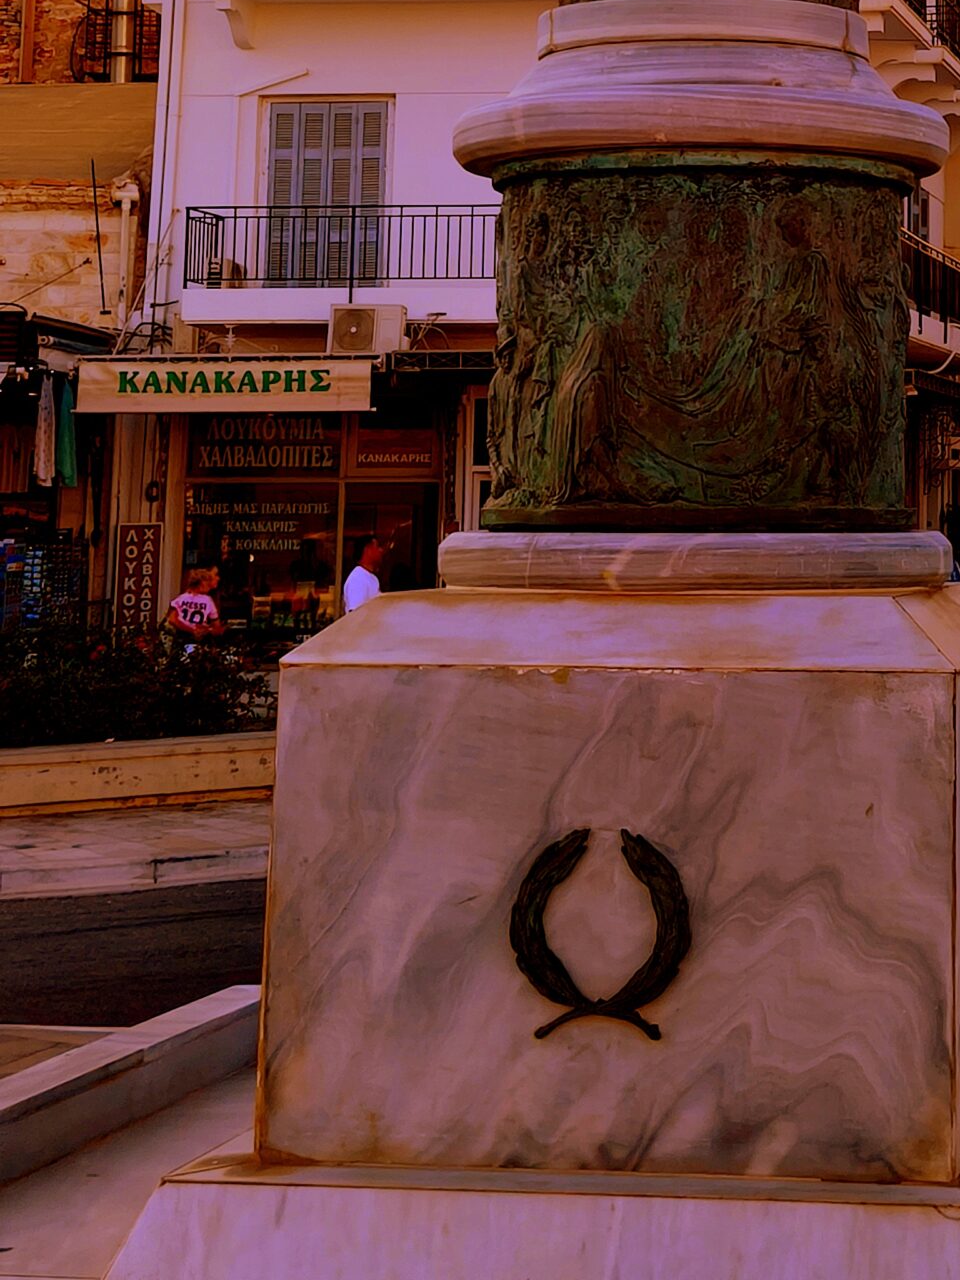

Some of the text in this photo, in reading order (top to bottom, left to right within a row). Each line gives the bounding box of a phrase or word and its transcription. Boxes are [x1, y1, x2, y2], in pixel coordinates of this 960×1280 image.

[117, 369, 332, 394] ΚΑΝΑΚΑΡΗΣ
[207, 417, 325, 441] ΛΟΥΚΟΥΜΙΑ
[198, 444, 334, 468] ΧΑΛΒΑΔΟΠΙΤΕΣ
[357, 452, 432, 464] ΚΑΝΑΚΑΡΗΣ
[181, 600, 207, 610] MESSI
[181, 606, 205, 625] 10
